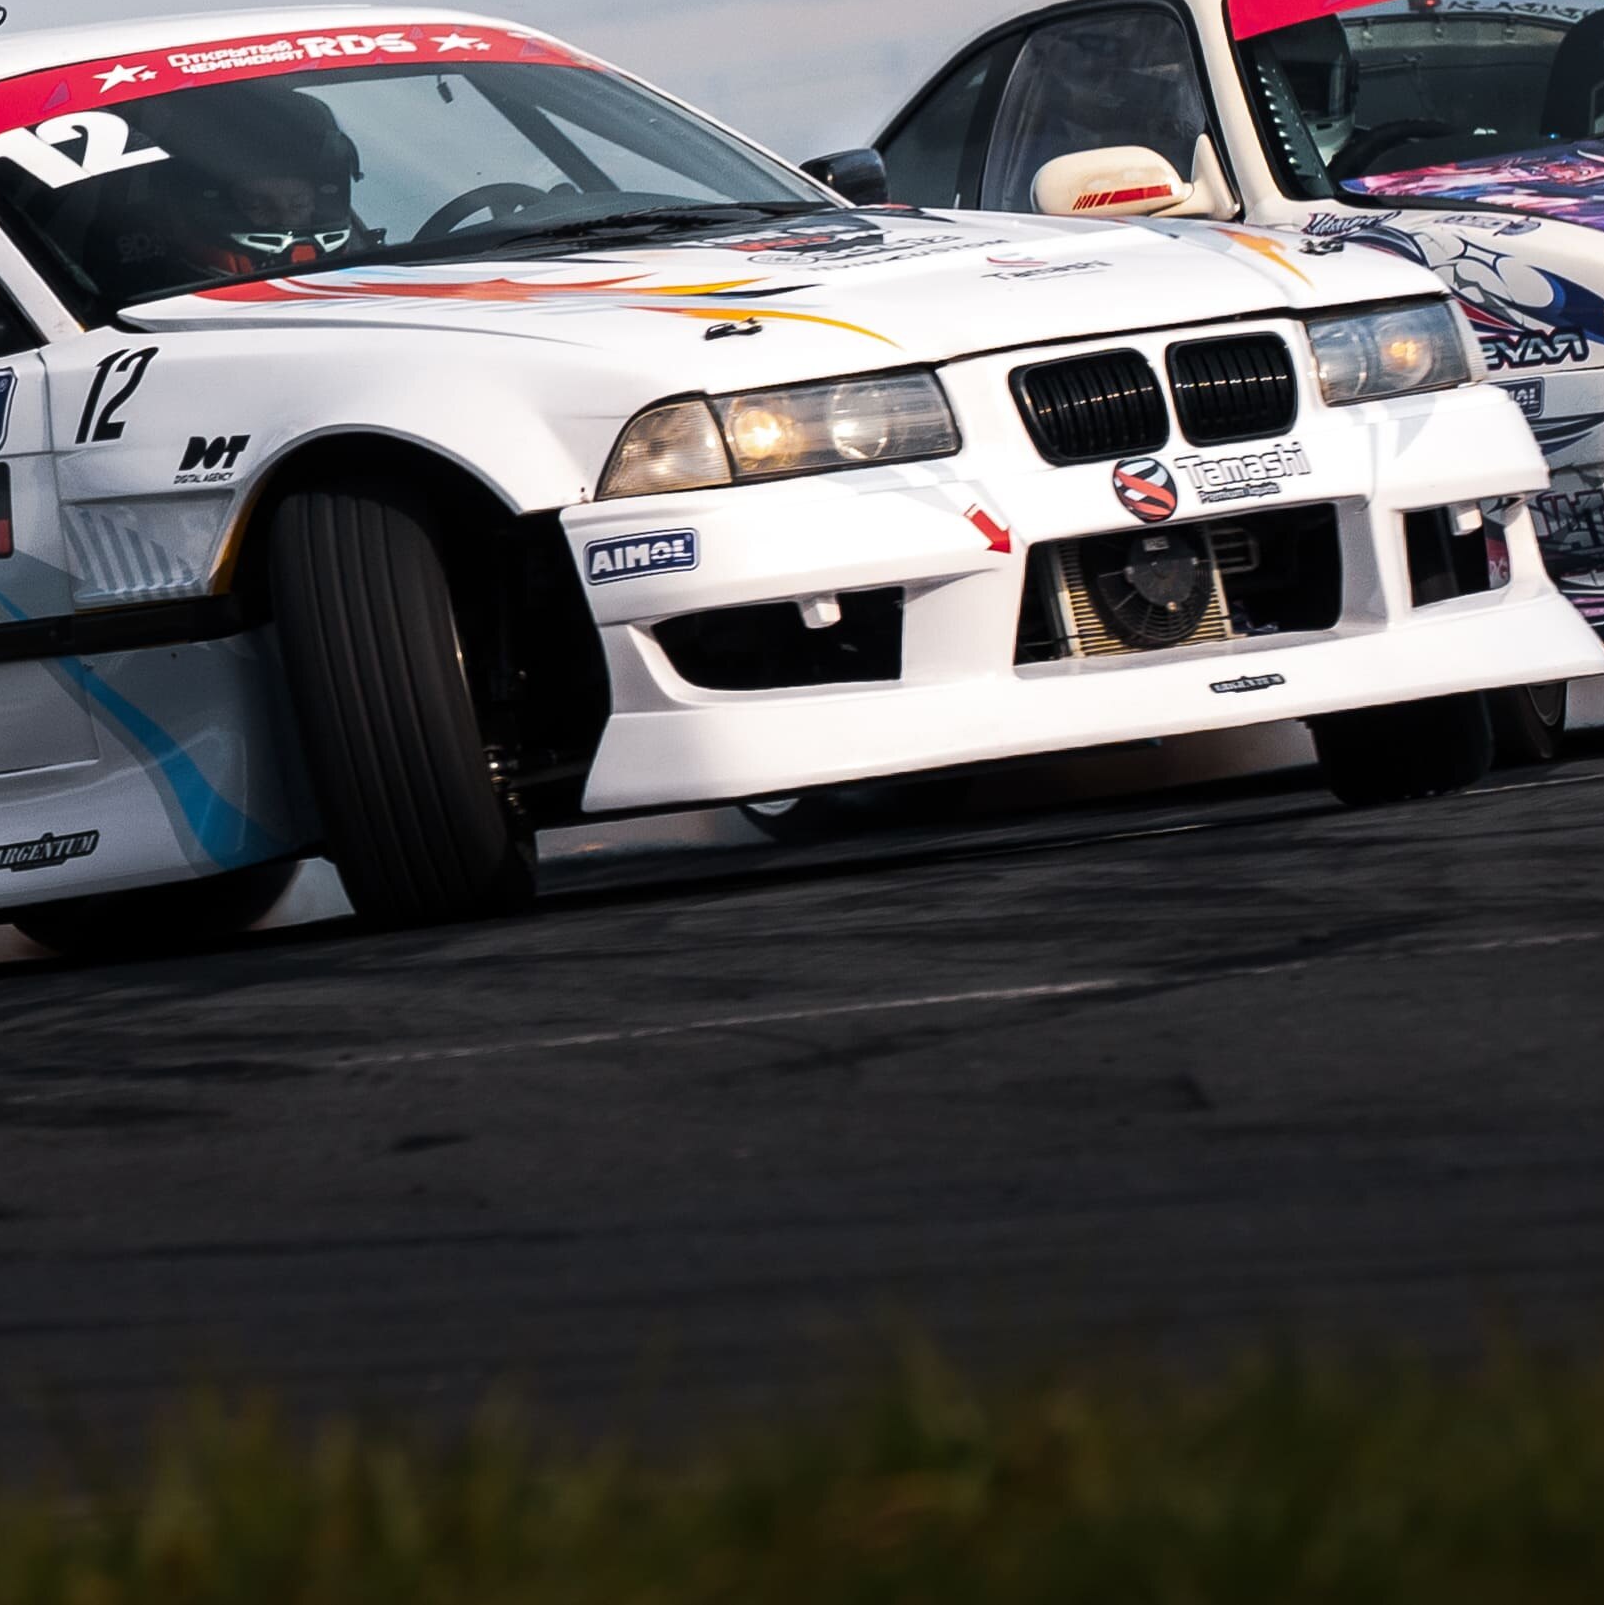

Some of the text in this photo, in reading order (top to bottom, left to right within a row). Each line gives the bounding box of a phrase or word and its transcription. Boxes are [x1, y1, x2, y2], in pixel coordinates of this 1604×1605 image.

[296, 33, 417, 58] RDS
[75, 346, 159, 444] 12
[203, 472, 235, 482] AGENCY
[1174, 443, 1311, 488] Tamashi
[592, 539, 692, 574] AIMOL
